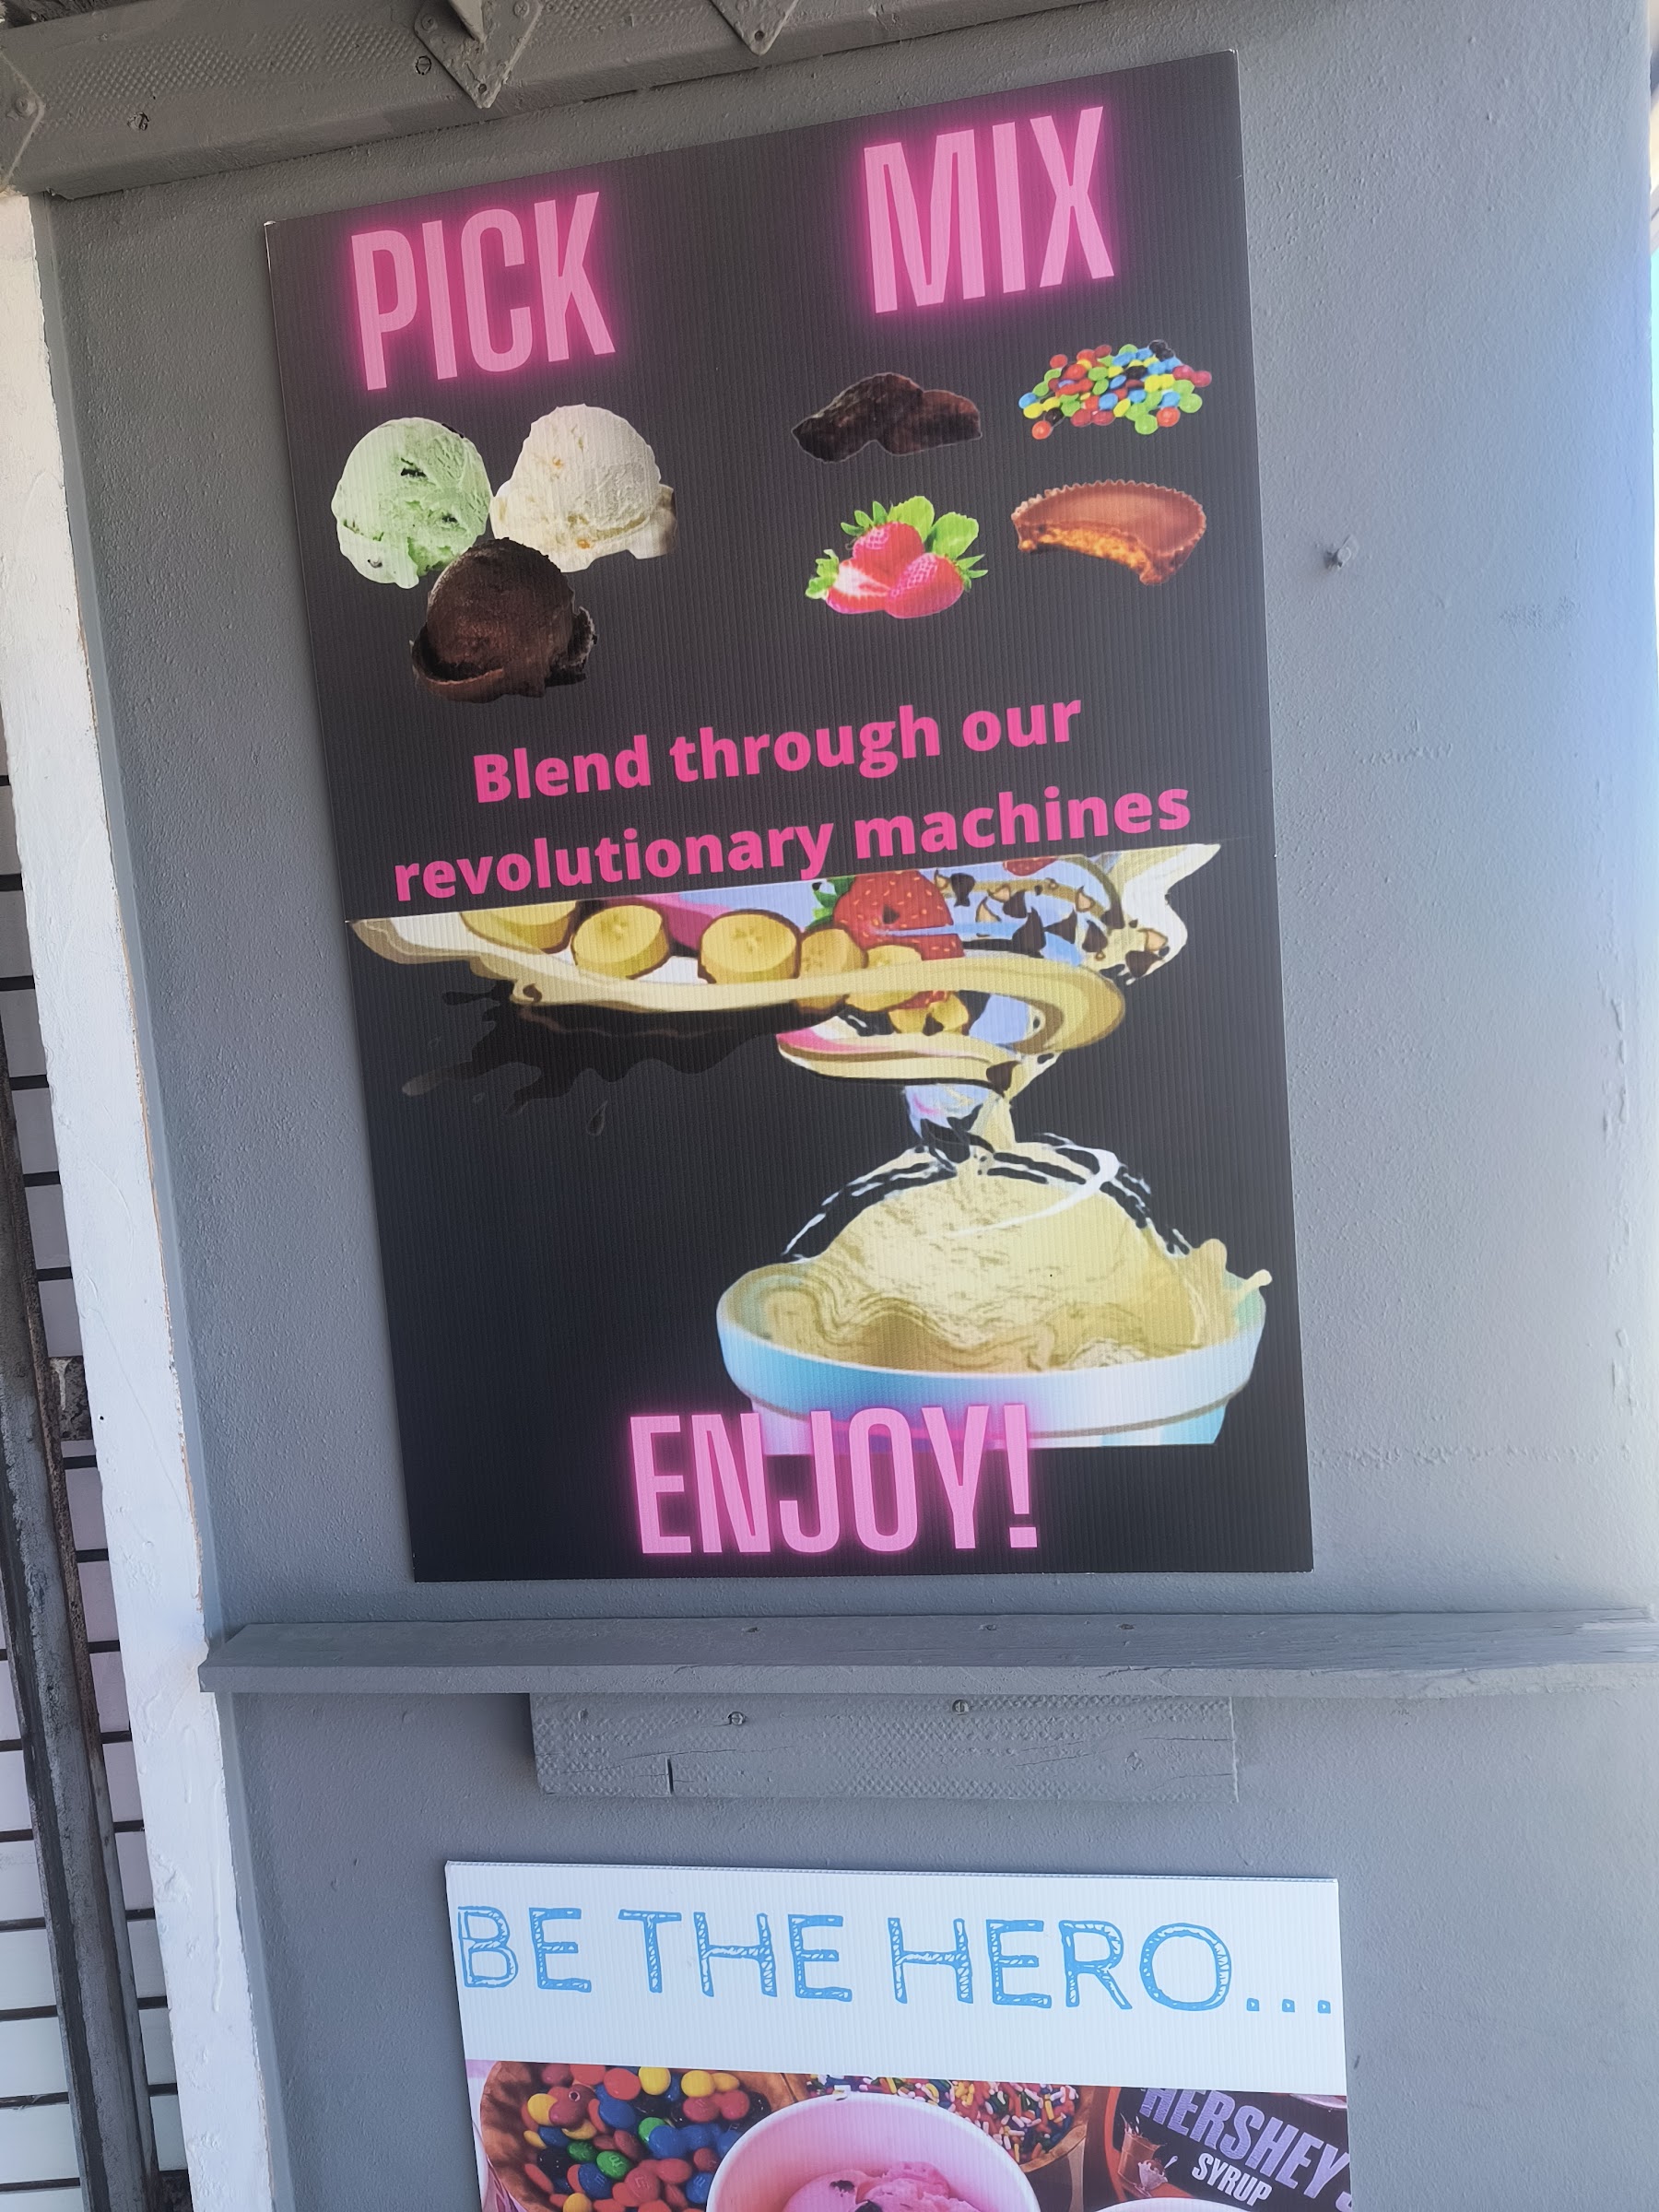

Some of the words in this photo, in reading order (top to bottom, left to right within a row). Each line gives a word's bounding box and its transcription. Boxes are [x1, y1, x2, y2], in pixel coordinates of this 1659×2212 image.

[863, 106, 1114, 313] MIX
[351, 191, 616, 391] PICK
[473, 734, 651, 803] Blend
[668, 704, 940, 782] through
[962, 700, 1082, 752] our
[394, 823, 834, 901] revolutionary
[854, 786, 1192, 859] machines
[629, 1404, 1041, 1554] ENJOY!
[456, 1904, 594, 1994] BE
[615, 1908, 853, 2004] THE
[886, 1916, 1333, 2016] HERO...
[1191, 2152, 1273, 2206] SYRUP
